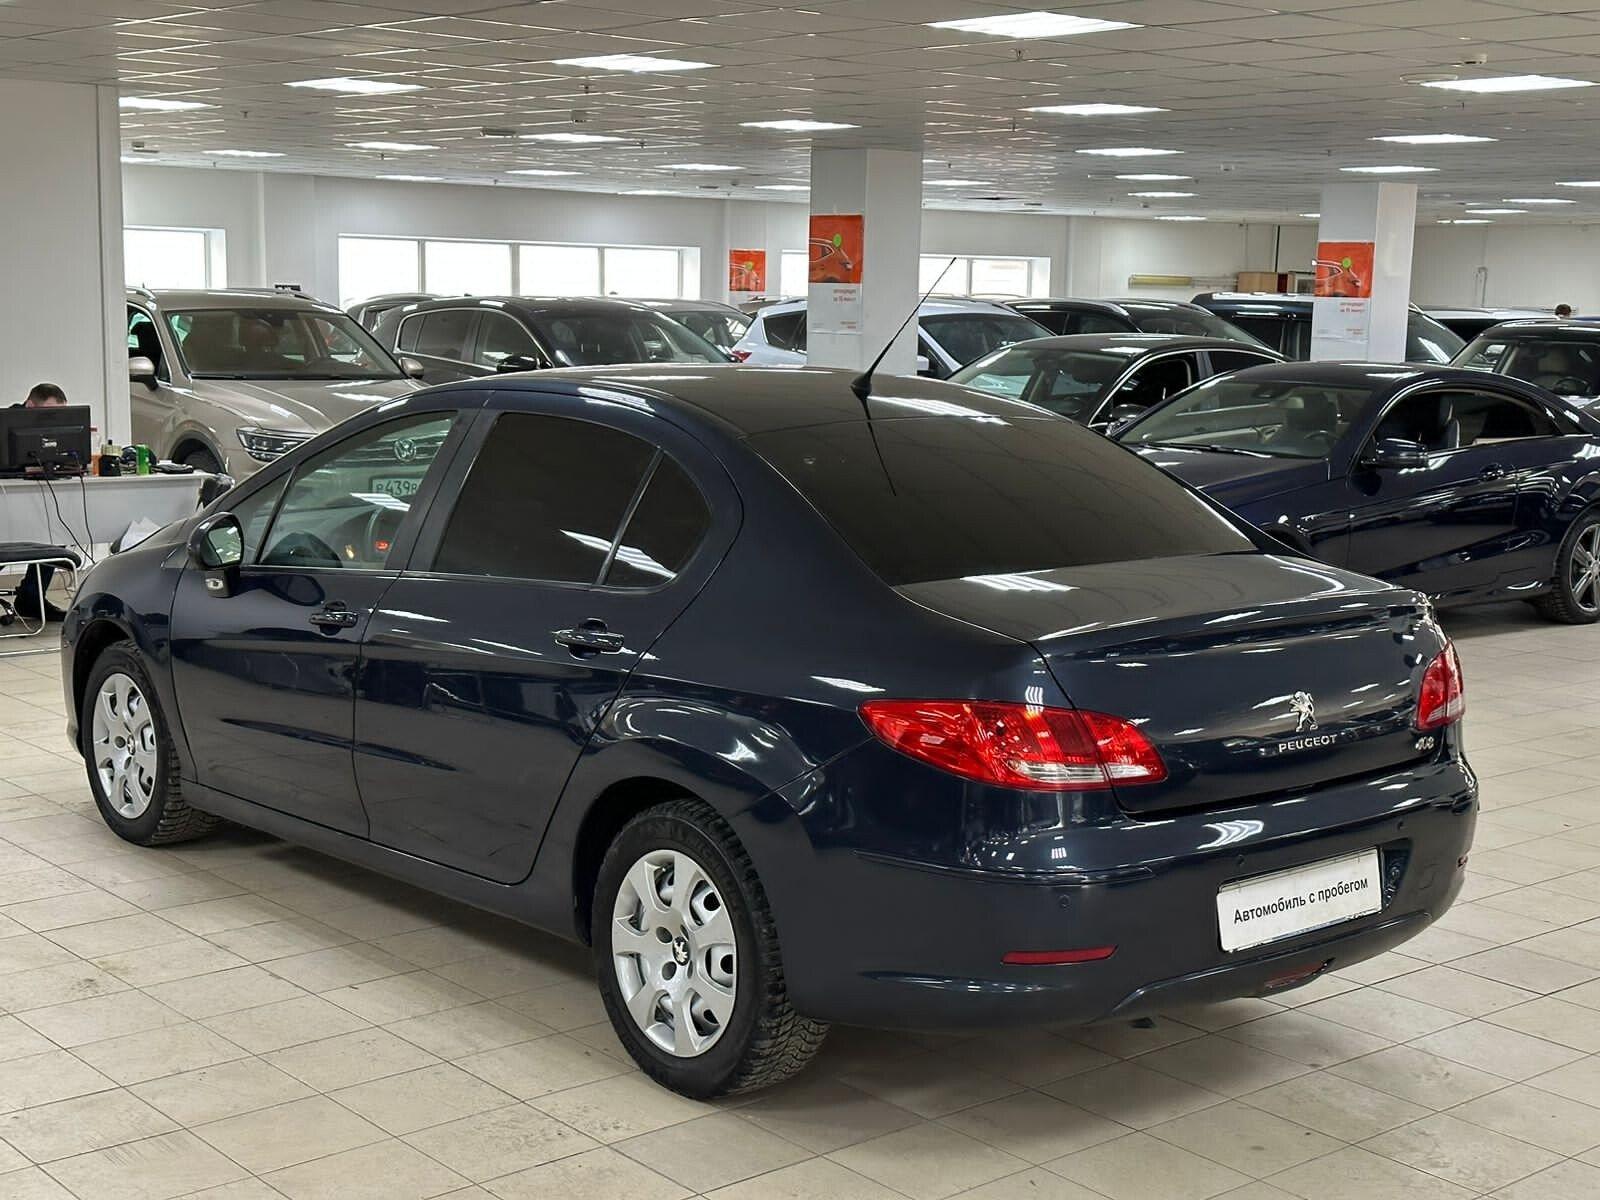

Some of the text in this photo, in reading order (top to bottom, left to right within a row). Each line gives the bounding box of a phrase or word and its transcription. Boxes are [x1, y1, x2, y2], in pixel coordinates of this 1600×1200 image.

[1278, 734, 1338, 753] PEUGEOT
[1233, 877, 1369, 925] Автомобиль с пробегом
